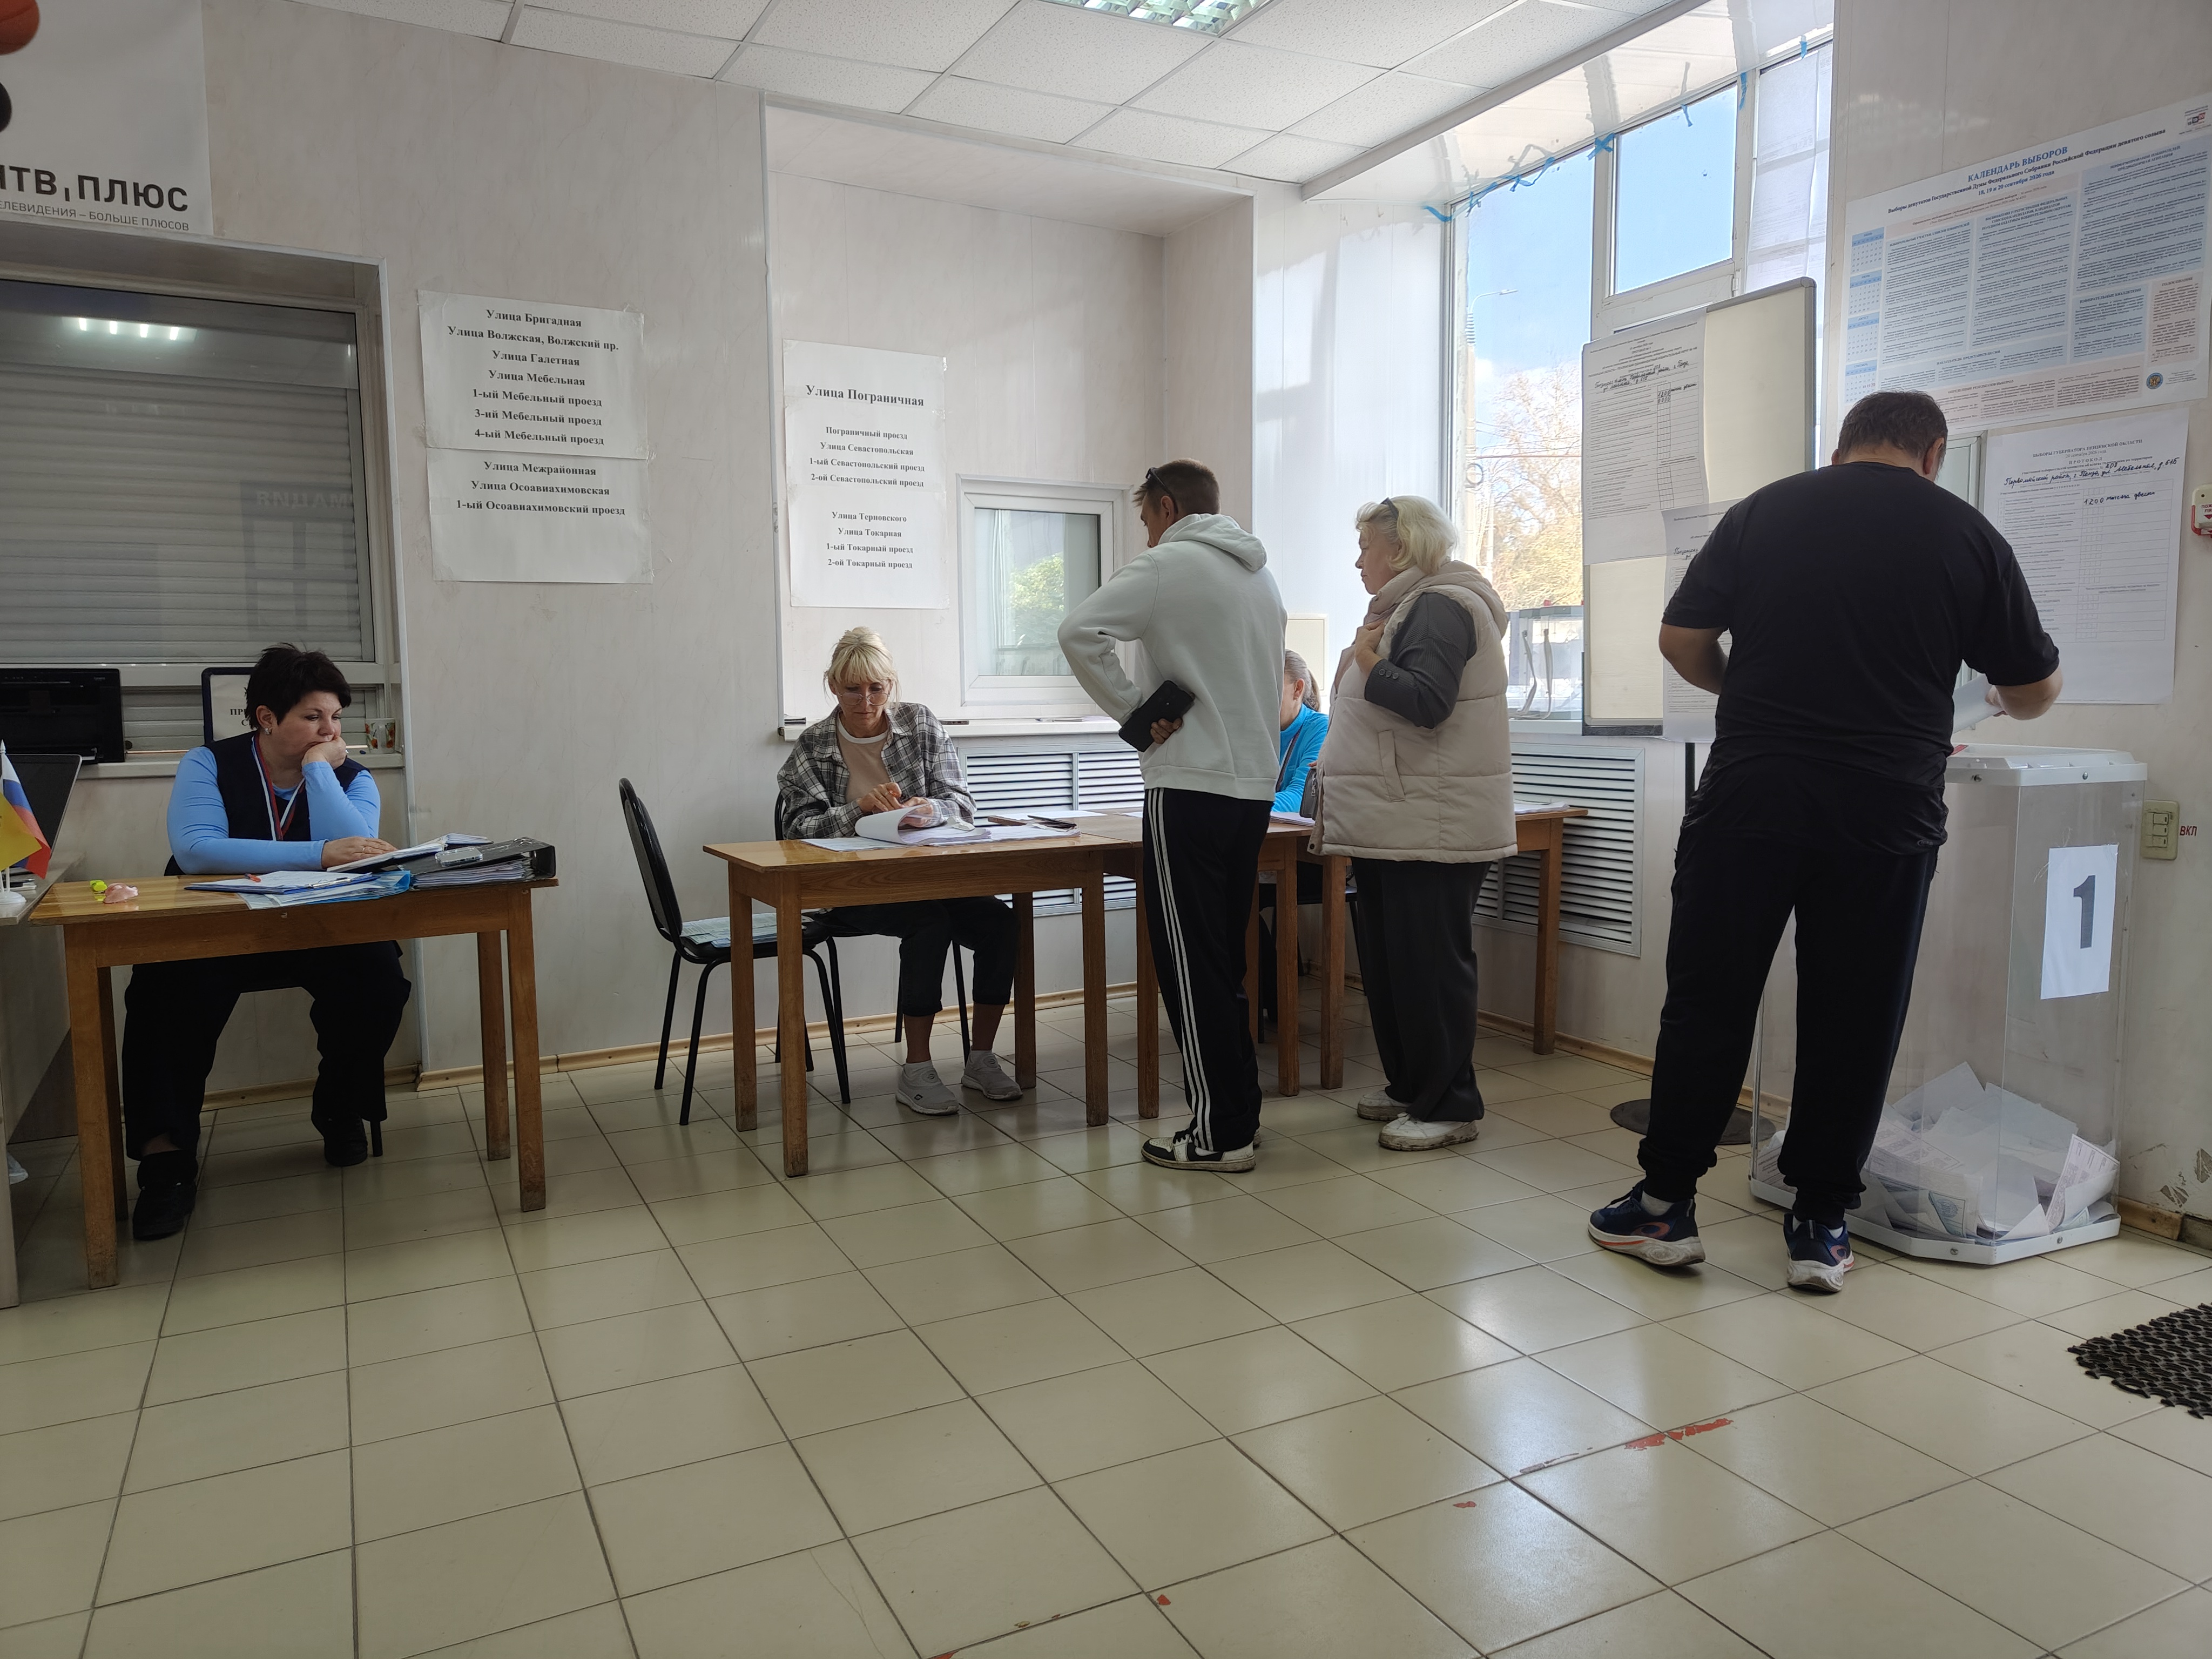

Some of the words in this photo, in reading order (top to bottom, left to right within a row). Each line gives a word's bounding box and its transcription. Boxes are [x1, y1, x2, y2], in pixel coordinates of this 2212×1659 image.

[1888, 204, 1907, 213] Выборы
[1908, 198, 1931, 209] депутатов
[1932, 185, 1972, 201] Государственной
[1973, 181, 1987, 191] Думы
[1988, 171, 2023, 184] Федерального
[2024, 162, 2052, 174] Собрания
[2052, 152, 2084, 165] Российской
[2085, 143, 2117, 156] Федерации
[2117, 135, 2143, 147] девятого
[2144, 129, 2166, 139] созыва
[1967, 161, 2020, 182] КАЛЕНДАРЬ
[2022, 147, 2068, 166] ВЫБОРОВ
[0, 165, 57, 195] ТВ
[78, 174, 188, 212] ПЛЮС
[89, 211, 138, 226] БОЛЬШЕ
[141, 218, 189, 231] ПЛЮСОВ
[486, 309, 521, 322] Улица
[525, 313, 581, 327] Бригадная
[448, 326, 484, 338] Улица
[487, 330, 544, 345] Волжская,
[547, 335, 600, 348] Волжский
[604, 343, 618, 352] пр.
[492, 350, 527, 362] Улица
[530, 354, 579, 366] Галетная
[488, 370, 523, 381] Улица
[527, 373, 585, 386] Мебельная
[473, 389, 498, 399] 1-ый
[502, 391, 565, 403] Мебельный
[568, 398, 602, 407] проезд
[806, 385, 844, 399] Улица
[848, 389, 923, 406] Пограничная
[475, 409, 498, 419] 3-ий
[502, 410, 564, 423] Мебельный
[568, 417, 602, 426] проезд
[475, 429, 501, 438] 4-ый
[504, 430, 567, 442] Мебельный
[570, 437, 604, 445] проезд
[826, 427, 880, 437] Пограничный
[820, 442, 846, 450] Улица
[848, 444, 913, 455] Севастопольская
[483, 461, 519, 472] Улица
[522, 463, 596, 475] Межрайонная
[831, 458, 898, 469] Севастопольский
[830, 474, 897, 485] Севастопольский
[471, 481, 507, 491] Улица
[510, 482, 609, 495] Осоавиахимовская
[457, 500, 482, 509] 1-ый
[486, 501, 589, 513] Осоавиахимовский
[592, 508, 625, 516] проезд
[832, 511, 857, 520] Улица
[859, 513, 907, 522] Терновского
[838, 528, 862, 536] Улица
[865, 529, 901, 538] Токарная
[847, 544, 886, 553] Токарный
[846, 559, 886, 568] Токарный
[2180, 825, 2197, 837] ВКЛ
[2073, 875, 2096, 949] 1
